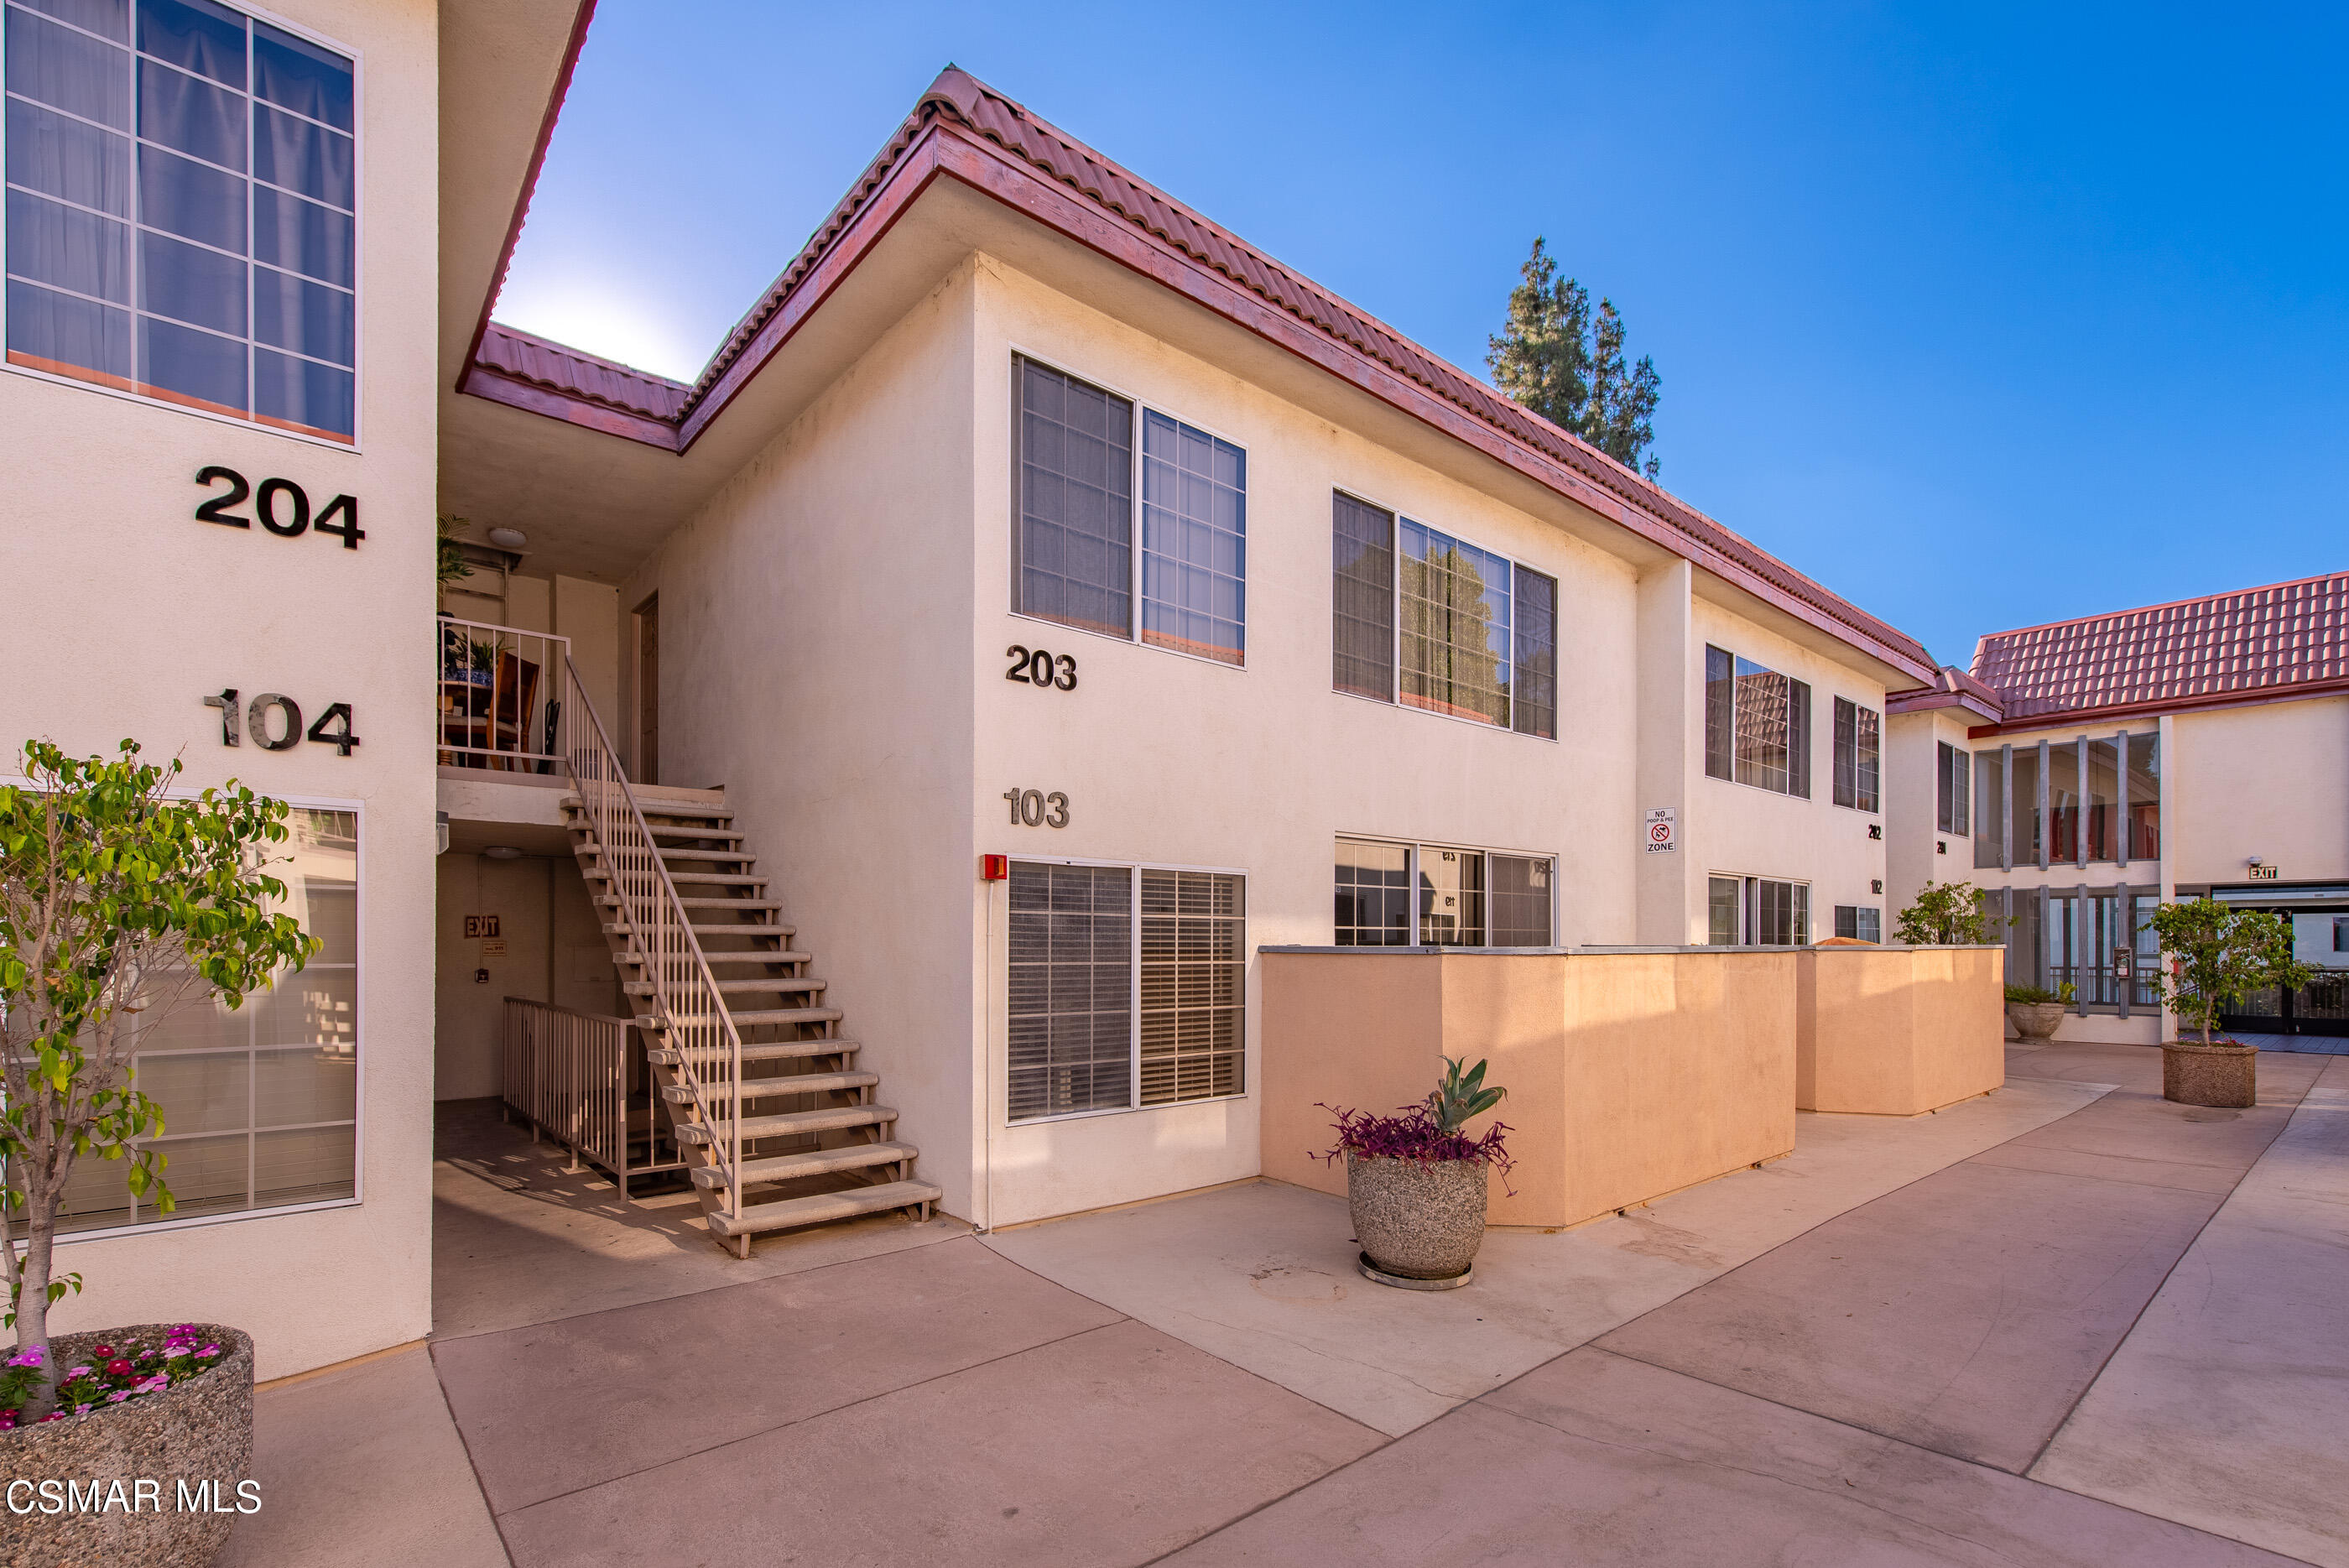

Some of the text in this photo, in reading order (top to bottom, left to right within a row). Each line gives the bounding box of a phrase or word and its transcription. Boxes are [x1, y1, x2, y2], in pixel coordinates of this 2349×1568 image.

[195, 466, 366, 550] 204
[1006, 644, 1077, 691] 203
[204, 688, 361, 757] 104
[1003, 787, 1070, 829] 103
[1648, 842, 1674, 852] ZONE
[1871, 879, 1882, 894] 102
[2250, 867, 2276, 878] EXIT
[467, 918, 497, 935] EXIT
